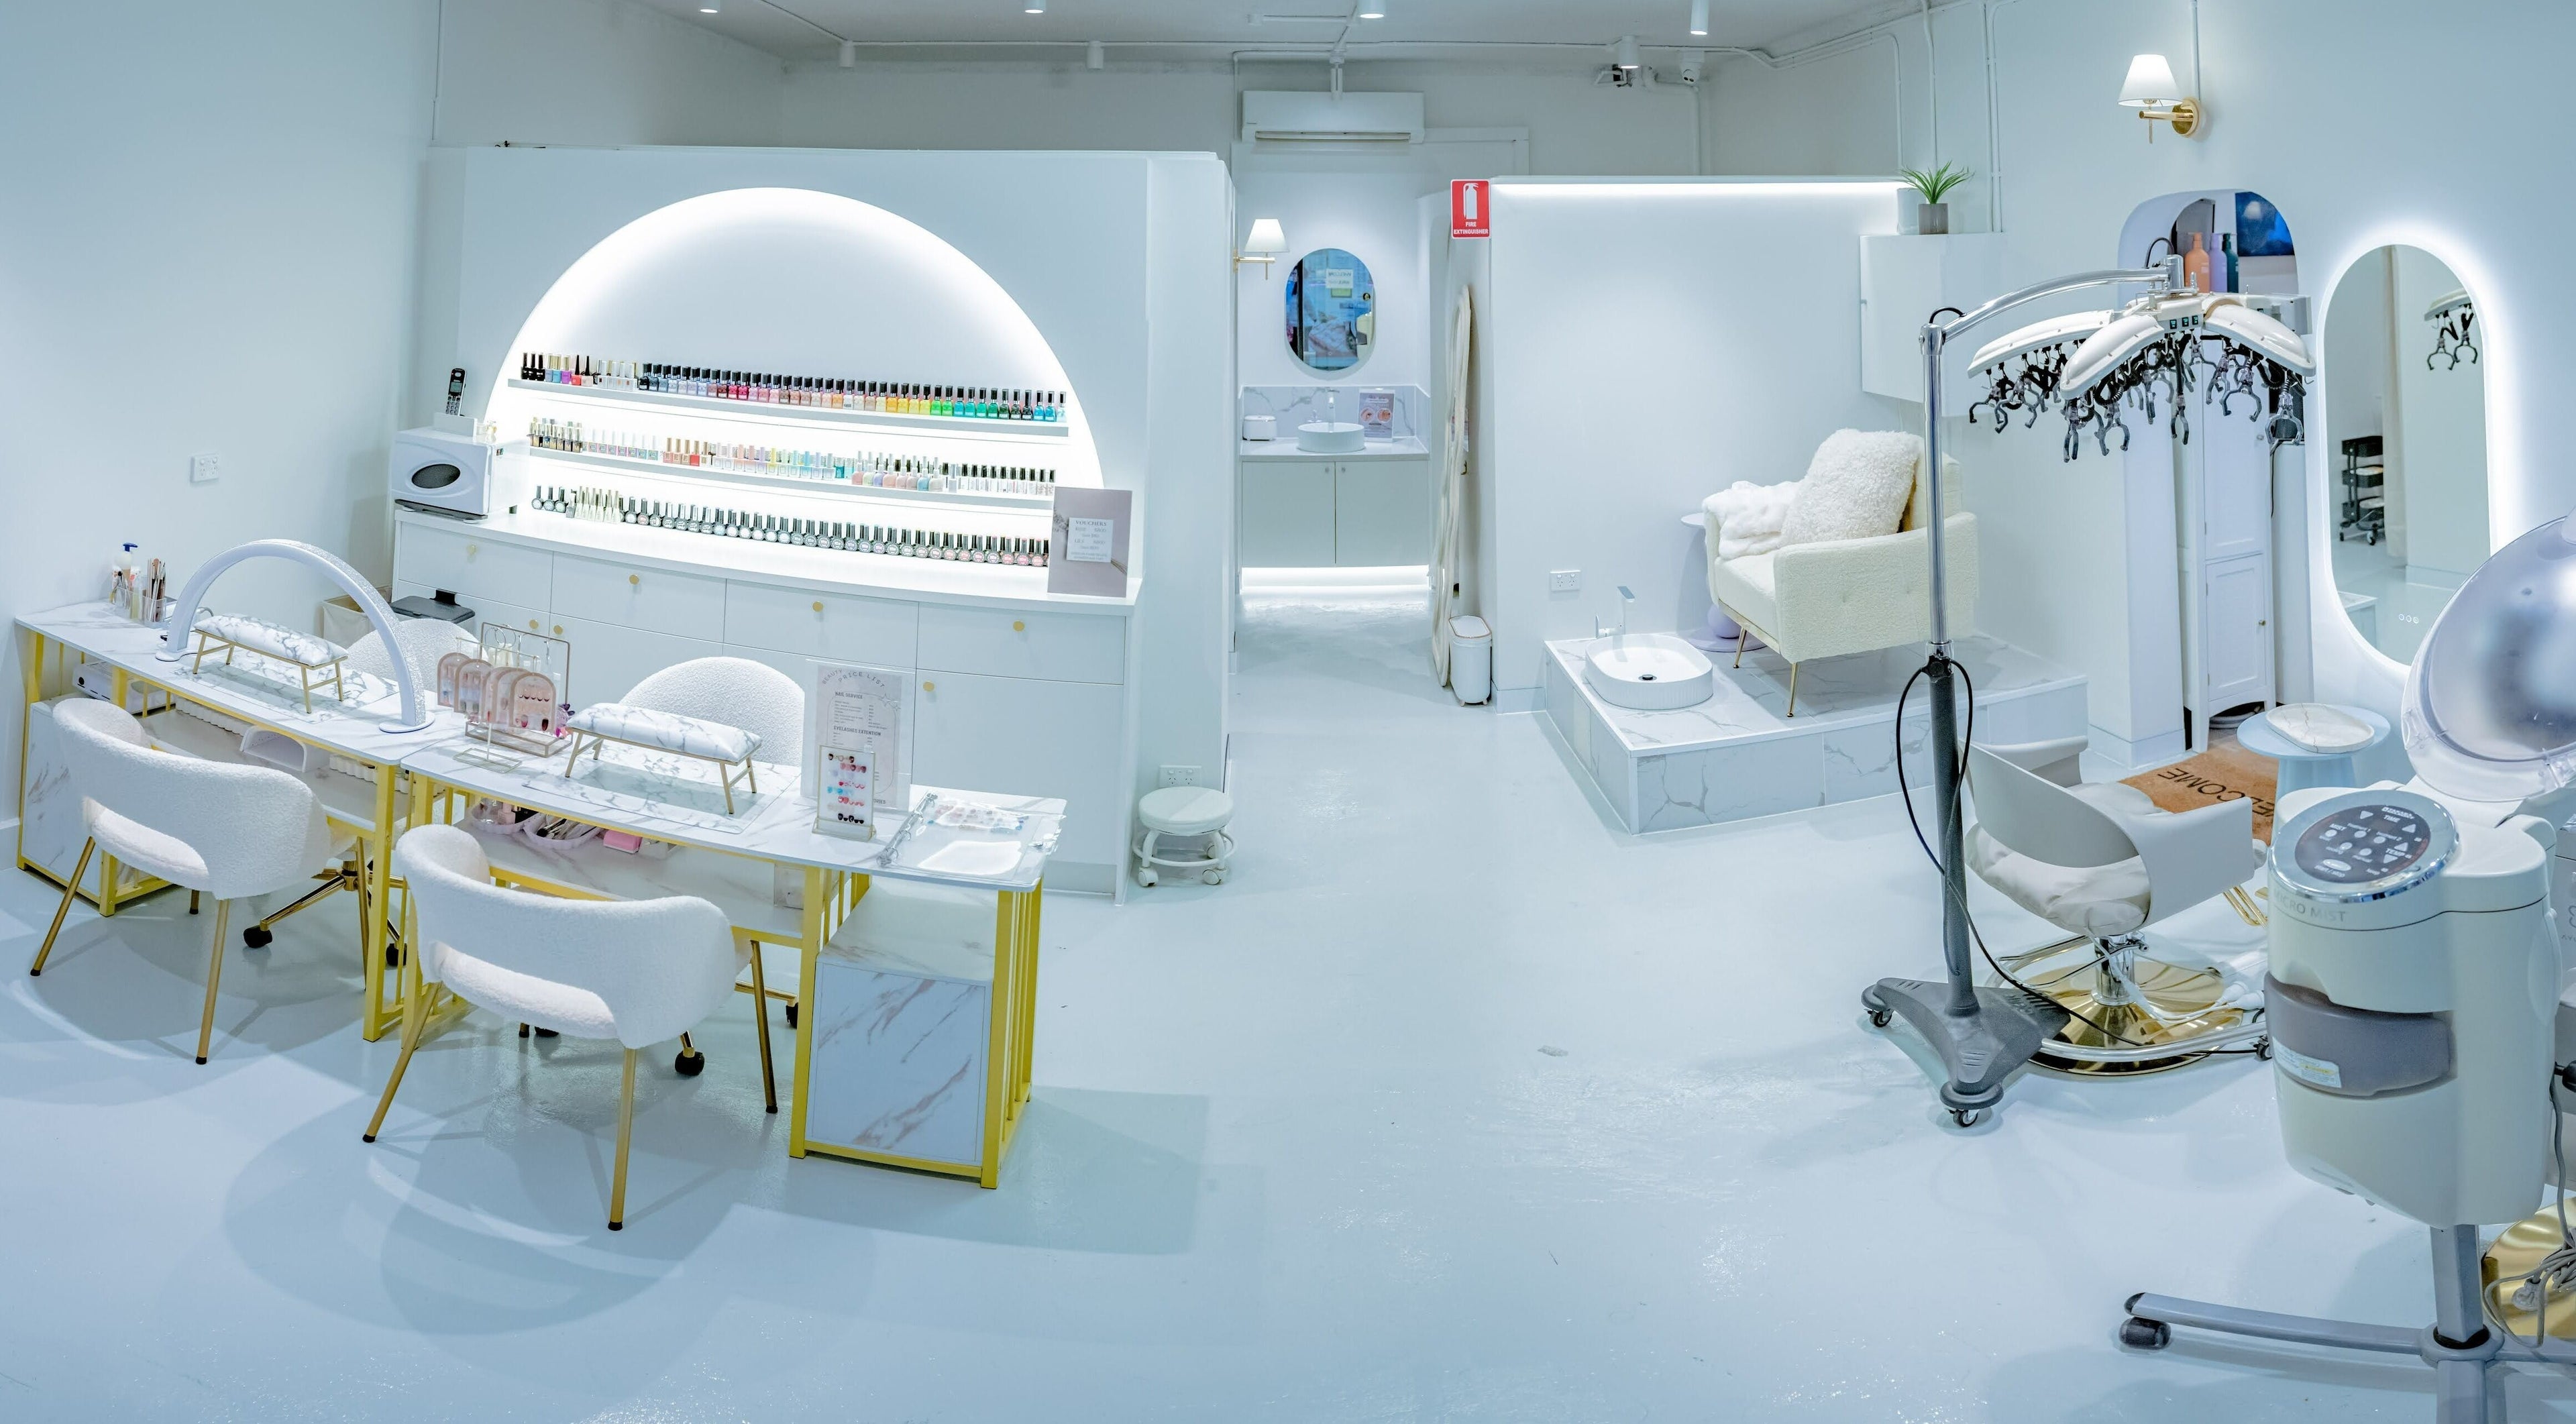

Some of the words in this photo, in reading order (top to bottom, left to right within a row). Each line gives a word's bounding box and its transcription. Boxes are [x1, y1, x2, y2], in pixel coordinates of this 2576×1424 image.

[822, 669, 843, 685] BEAUTY
[838, 671, 863, 682] PRICE
[867, 673, 885, 688] LIST
[834, 726, 858, 734] EYELASHES
[2383, 814, 2401, 823] TIME
[2310, 906, 2346, 922] MIST
